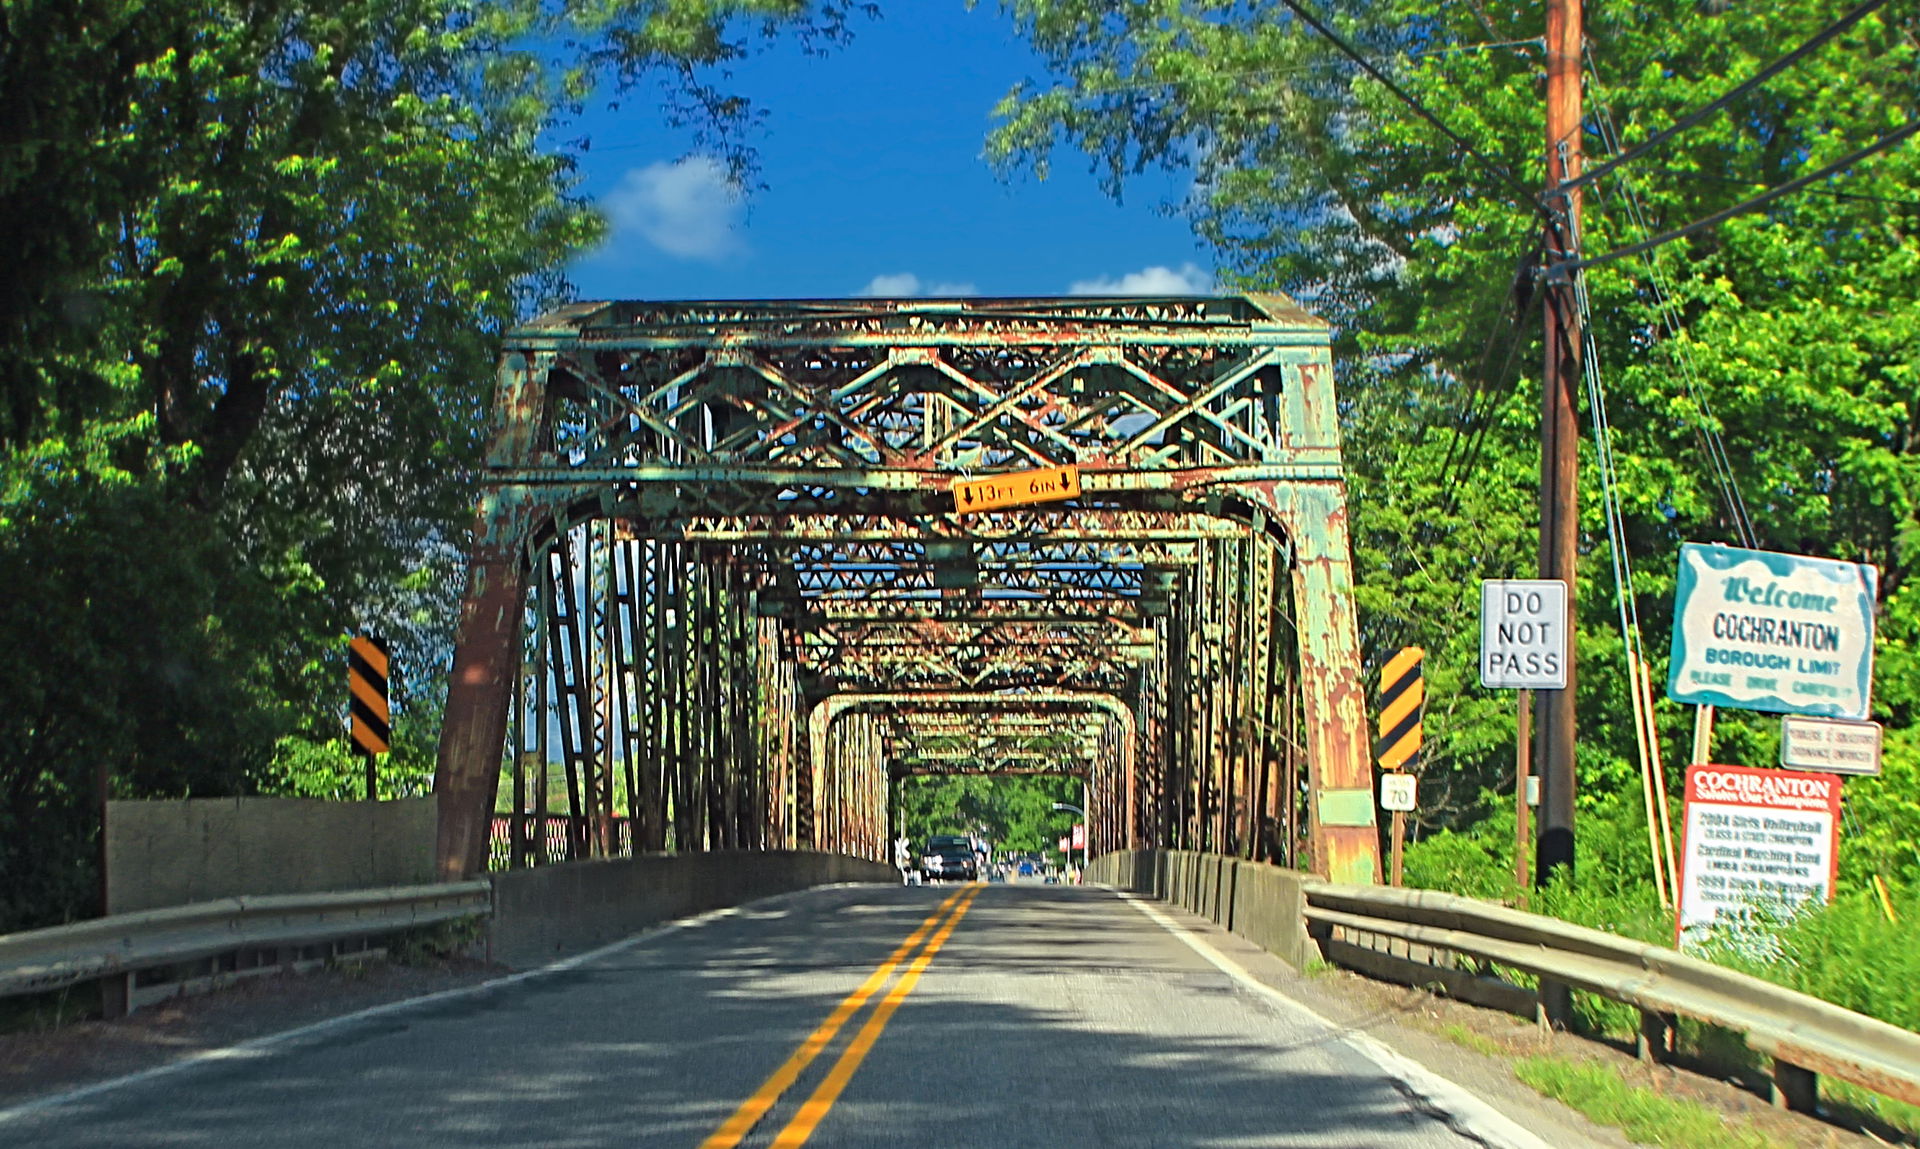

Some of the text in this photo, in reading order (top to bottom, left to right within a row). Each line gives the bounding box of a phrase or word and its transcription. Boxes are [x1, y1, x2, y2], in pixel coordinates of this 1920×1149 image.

[1030, 479, 1056, 494] 6IN
[1506, 592, 1542, 614] DO
[1721, 576, 1838, 613] Welcome
[1499, 622, 1551, 645] NOT
[1713, 612, 1840, 652] COCHRANTON
[1489, 652, 1559, 675] PASS
[1705, 647, 1841, 675] BOROUGH LIMIT
[1690, 670, 1732, 687] PLEASE
[1694, 770, 1831, 798] COCHRANTON
[1390, 790, 1408, 804] 70
